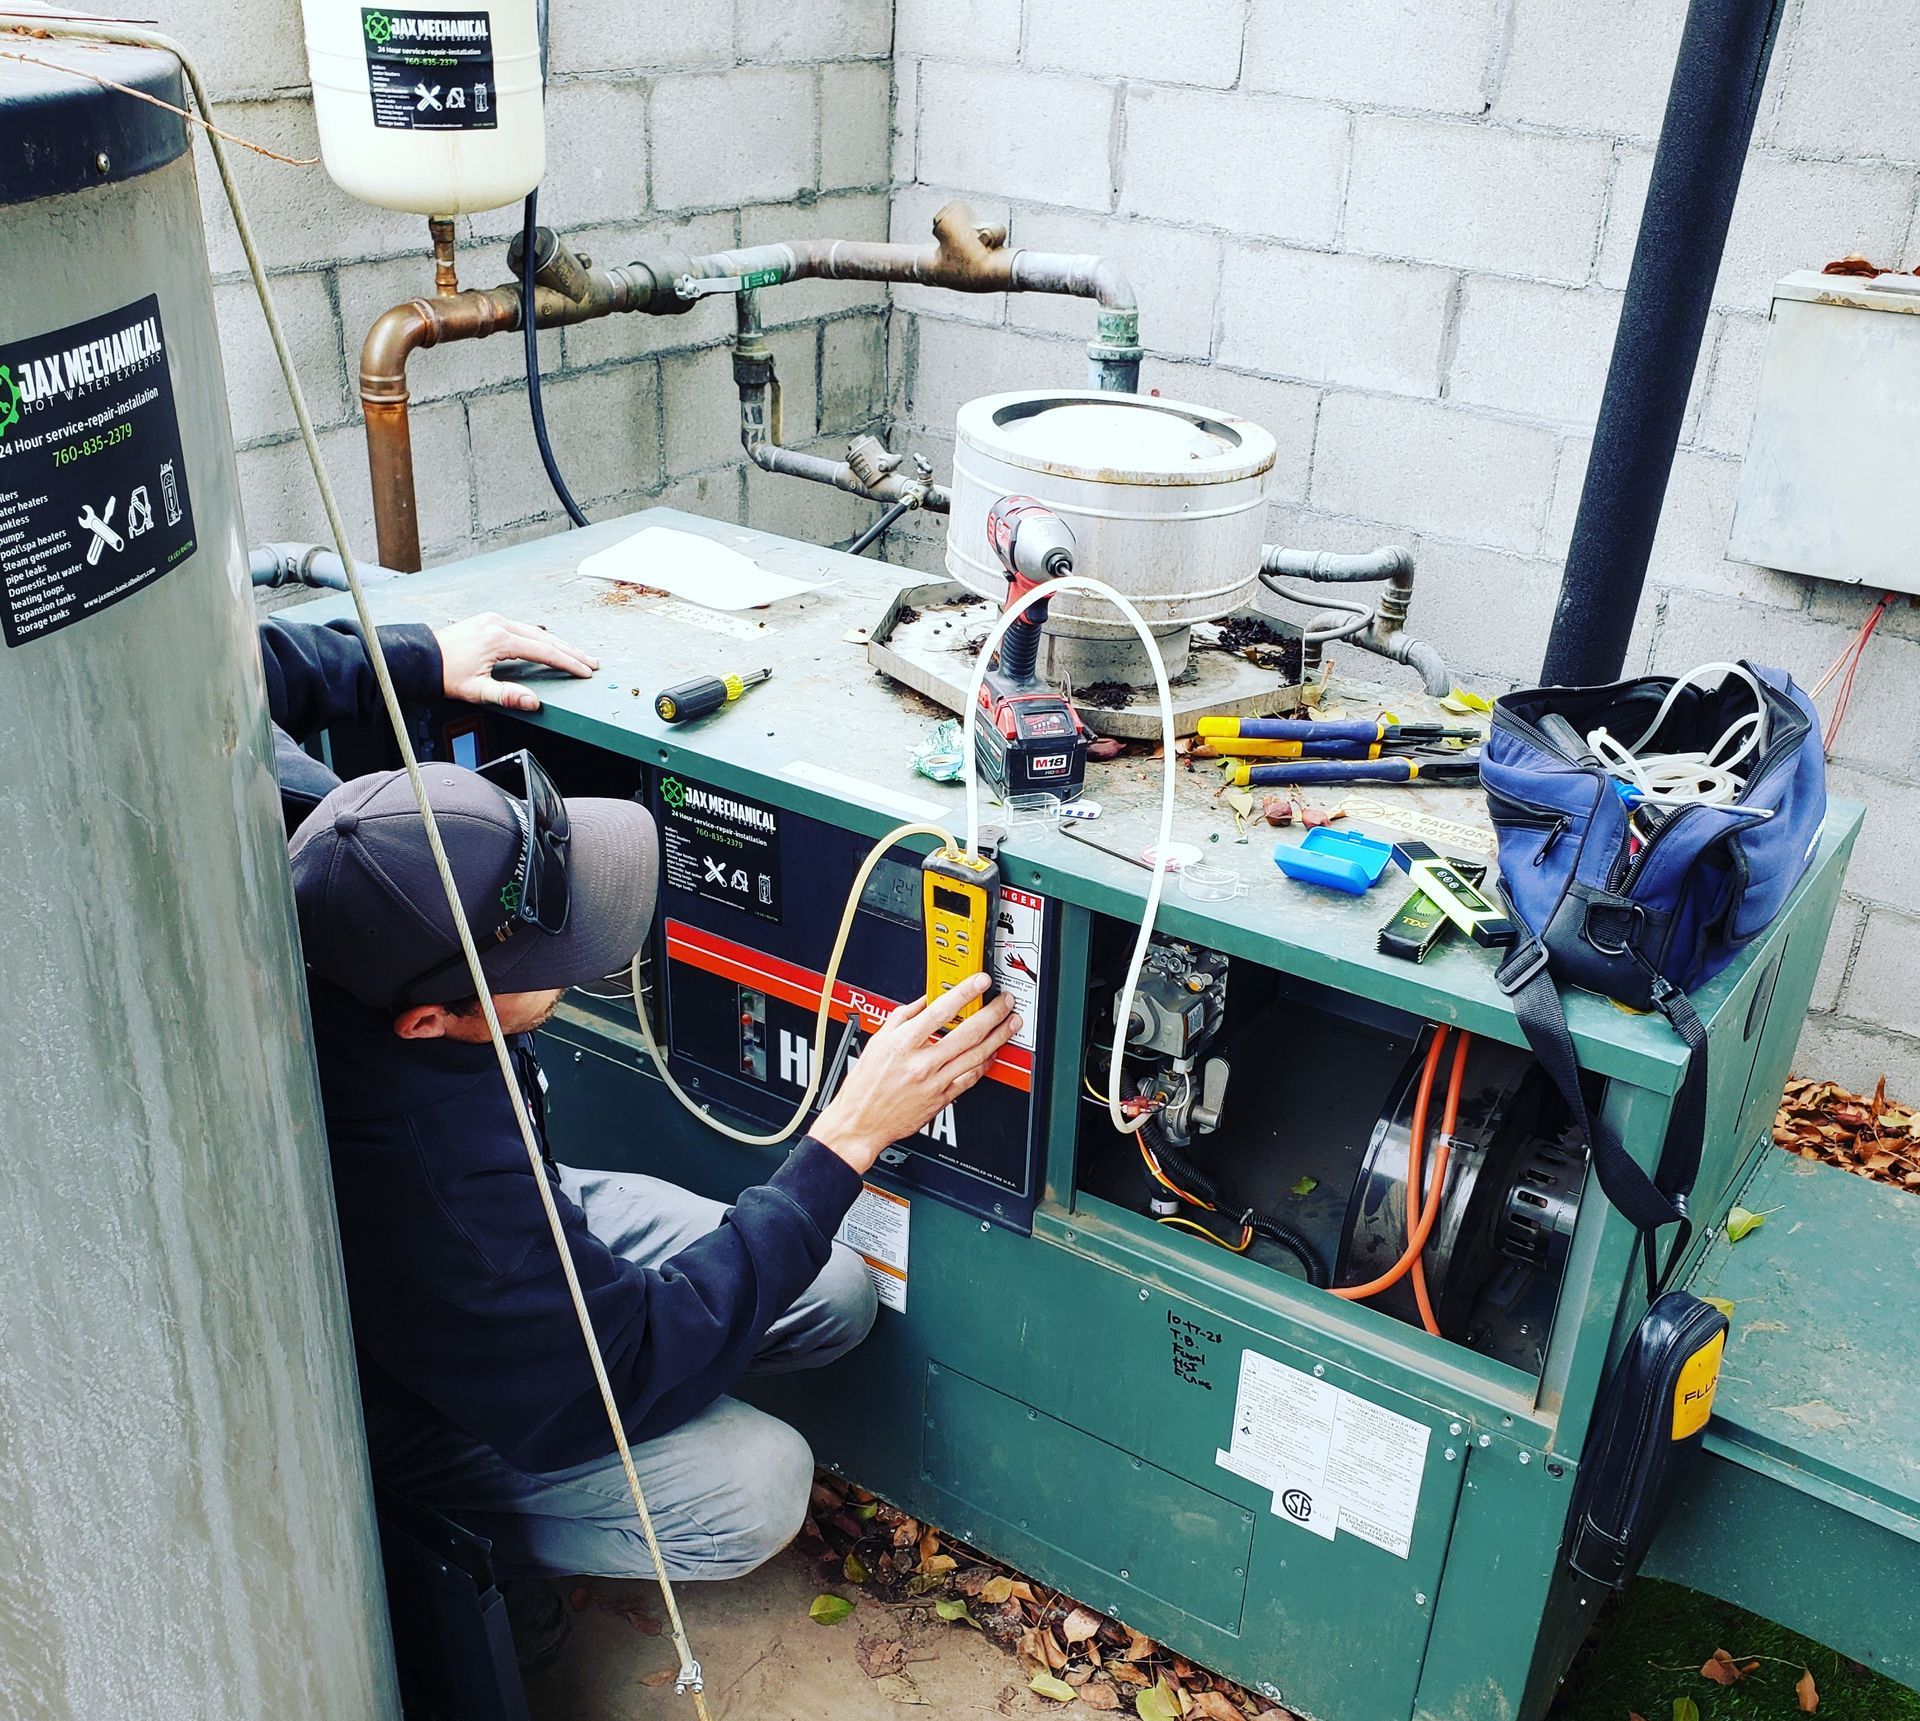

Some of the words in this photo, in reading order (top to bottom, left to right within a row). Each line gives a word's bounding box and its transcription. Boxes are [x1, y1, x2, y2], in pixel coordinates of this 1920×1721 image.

[392, 18, 417, 36] JAX
[417, 19, 489, 37] MECHANICAL
[377, 45, 386, 53] 24
[386, 46, 401, 54] Hour
[404, 57, 458, 66] 760-835-2379
[18, 354, 66, 403] JAX
[63, 317, 161, 388] MECHANICAL
[23, 395, 54, 415] HOT
[64, 376, 111, 401] WATER
[117, 351, 161, 382] EXPERTS
[15, 434, 43, 453] Hour
[45, 386, 159, 444] service-repair-installation
[52, 422, 133, 467] 760-835-2379
[0, 490, 19, 503] ilers
[0, 506, 17, 517] ater
[18, 495, 49, 512] heaters
[0, 514, 30, 530] ankless
[37, 529, 67, 546] heaters
[3, 558, 30, 572] Steam
[30, 541, 72, 565] generators
[6, 572, 24, 587] pipe
[25, 564, 47, 580] leaks
[8, 578, 47, 598] Domestic
[47, 571, 60, 584] hot
[61, 562, 83, 579] water
[11, 592, 43, 610] heating
[43, 584, 65, 601] loops
[14, 602, 55, 623] Expansion
[55, 592, 76, 606] tanks
[16, 618, 48, 635] Storage
[49, 608, 70, 623] tanks
[1035, 758, 1064, 769] M18
[685, 787, 708, 809] JAX
[708, 794, 776, 832] MECHANICAL
[671, 809, 679, 817] 24
[679, 812, 693, 822] Hour
[693, 817, 768, 847] service-repair-installation
[695, 827, 743, 849] 760-835-2379
[1414, 825, 1445, 839] NOT
[1419, 817, 1488, 840] CAUTION
[1001, 889, 1037, 908] NGER
[1402, 916, 1429, 929] TDS
[848, 989, 892, 1025] Ray
[938, 1153, 960, 1165] PROUDLY
[960, 1161, 987, 1176] ASSEMBLED
[993, 1174, 1003, 1182] THE
[1683, 1375, 1718, 1405] FLU
